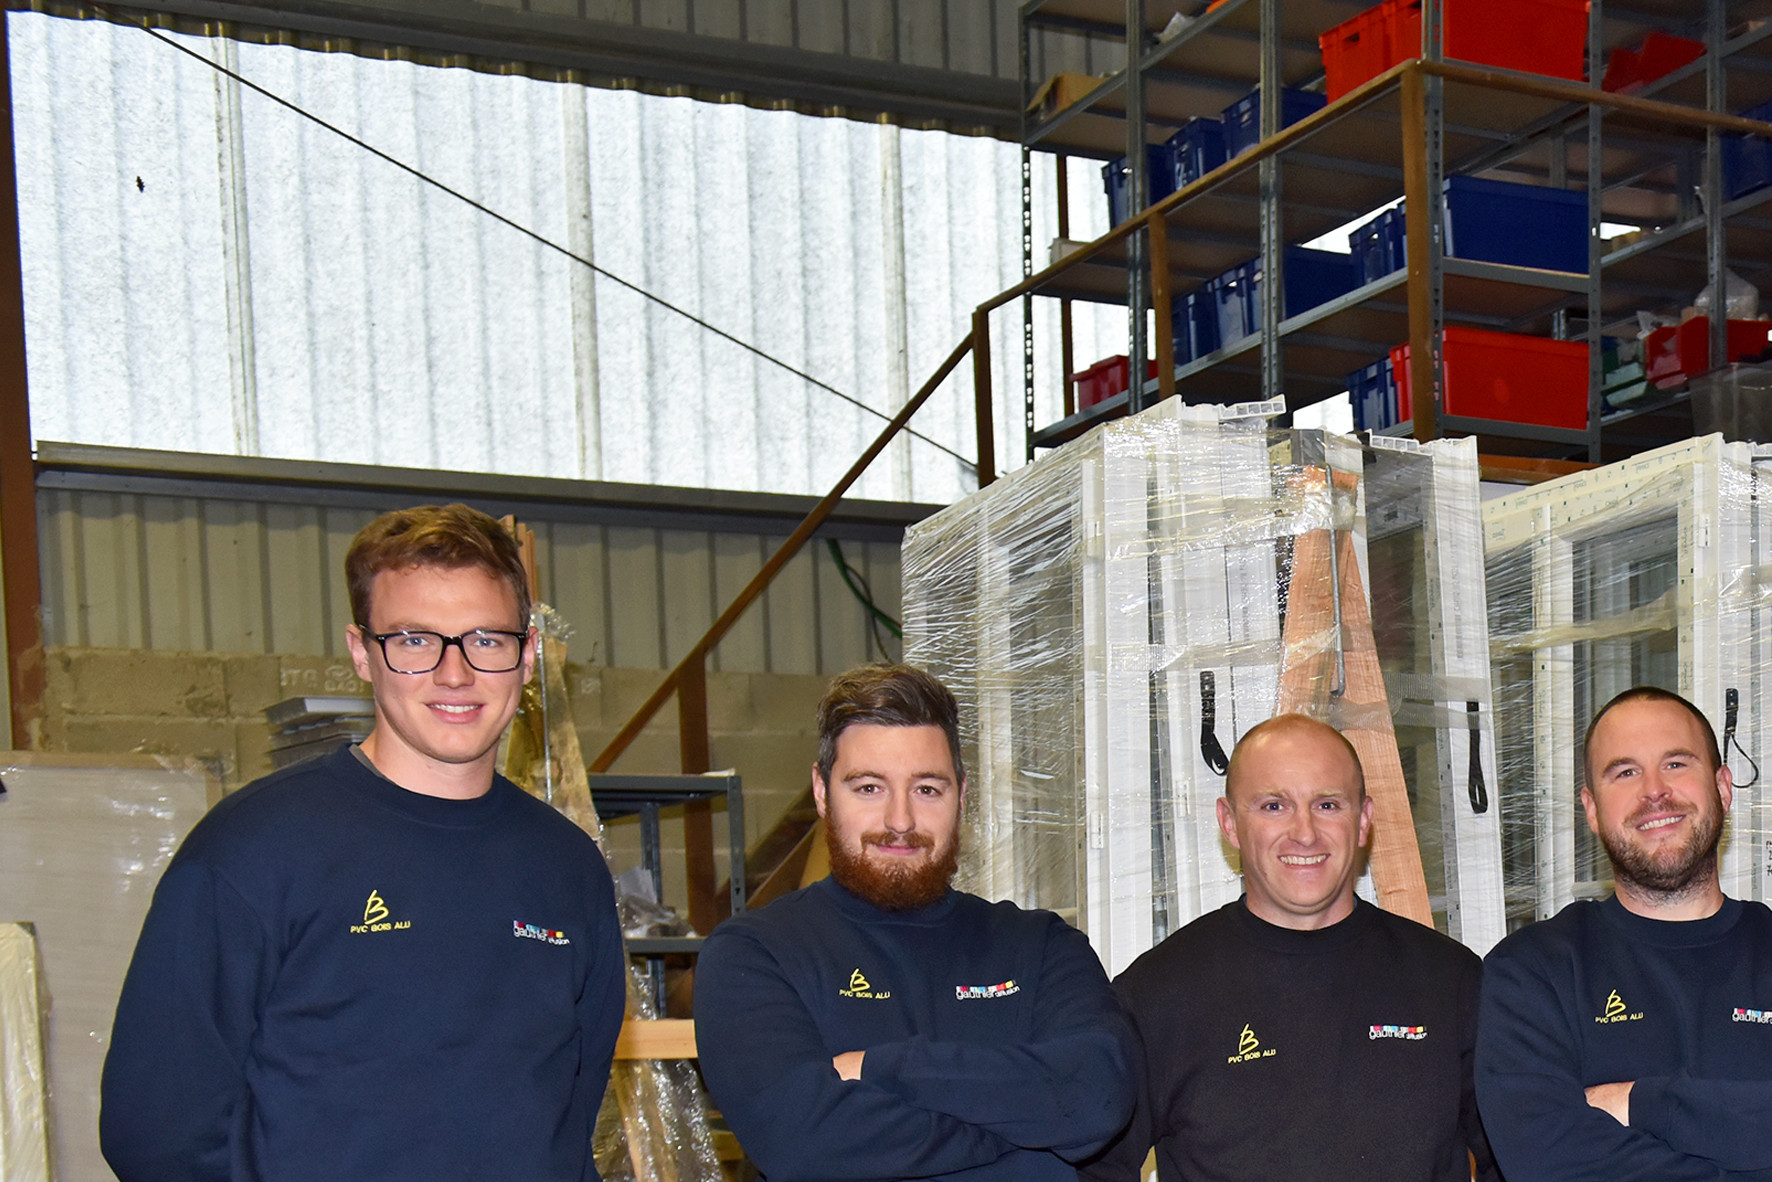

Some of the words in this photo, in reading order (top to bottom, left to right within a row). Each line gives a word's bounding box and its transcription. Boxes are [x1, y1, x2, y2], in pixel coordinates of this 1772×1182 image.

[350, 925, 368, 933] PVC
[371, 922, 391, 932] BOIS
[394, 920, 411, 930] ALU
[1228, 1055, 1242, 1064] PVC
[1245, 1052, 1261, 1061] BOIS
[1262, 1049, 1276, 1057] ALU
